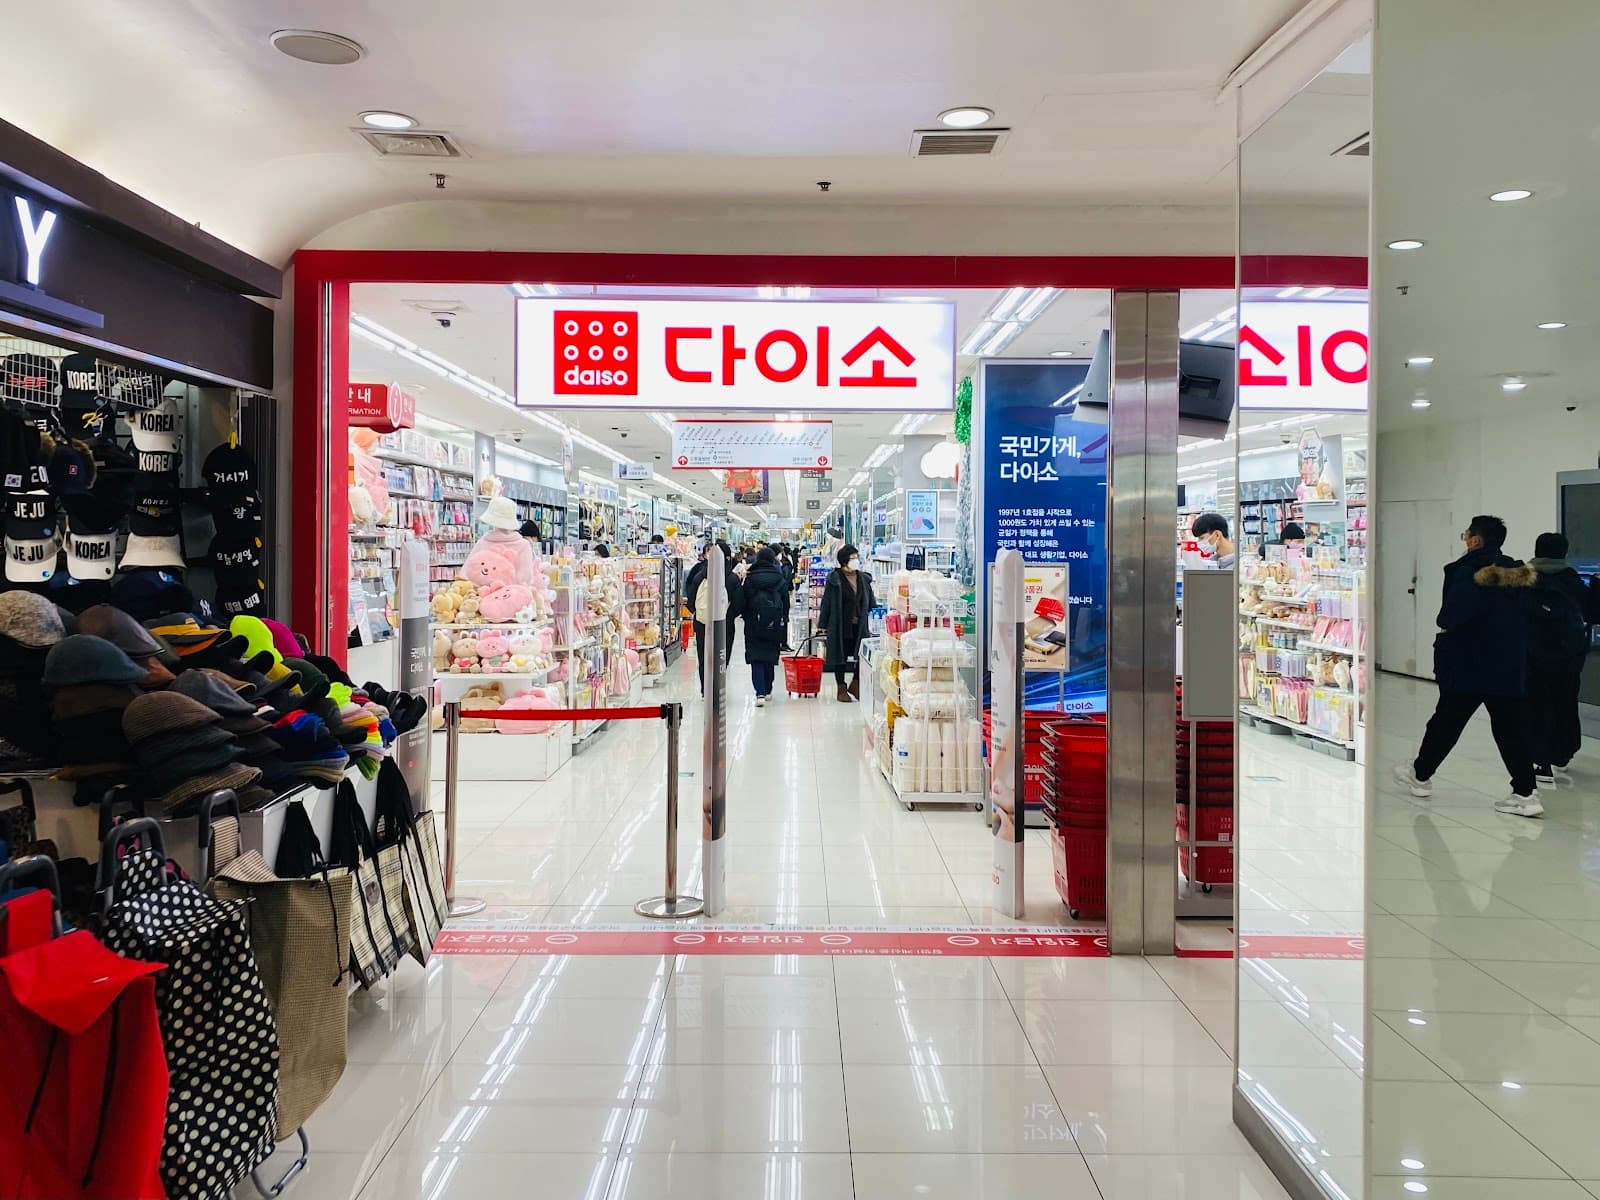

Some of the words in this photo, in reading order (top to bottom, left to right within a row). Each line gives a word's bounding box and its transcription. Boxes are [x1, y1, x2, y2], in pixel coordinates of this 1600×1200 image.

[15, 195, 57, 286] Y
[665, 325, 917, 387] 다이소
[563, 365, 629, 387] daiso
[140, 412, 174, 432] KOREA
[1000, 435, 1082, 459] 국민가게,
[139, 452, 173, 472] KOREA
[213, 470, 249, 483] 거시기
[1000, 461, 1059, 483] 다이소
[998, 508, 1020, 517] 1997년
[1046, 508, 1072, 517] 시작으로
[1073, 519, 1080, 527] 수
[75, 541, 111, 560] KOREA
[1069, 551, 1089, 559] 다이소
[1066, 701, 1094, 711] 다이소
[717, 935, 805, 945] 진입금지
[990, 936, 1081, 947] 진입금지
